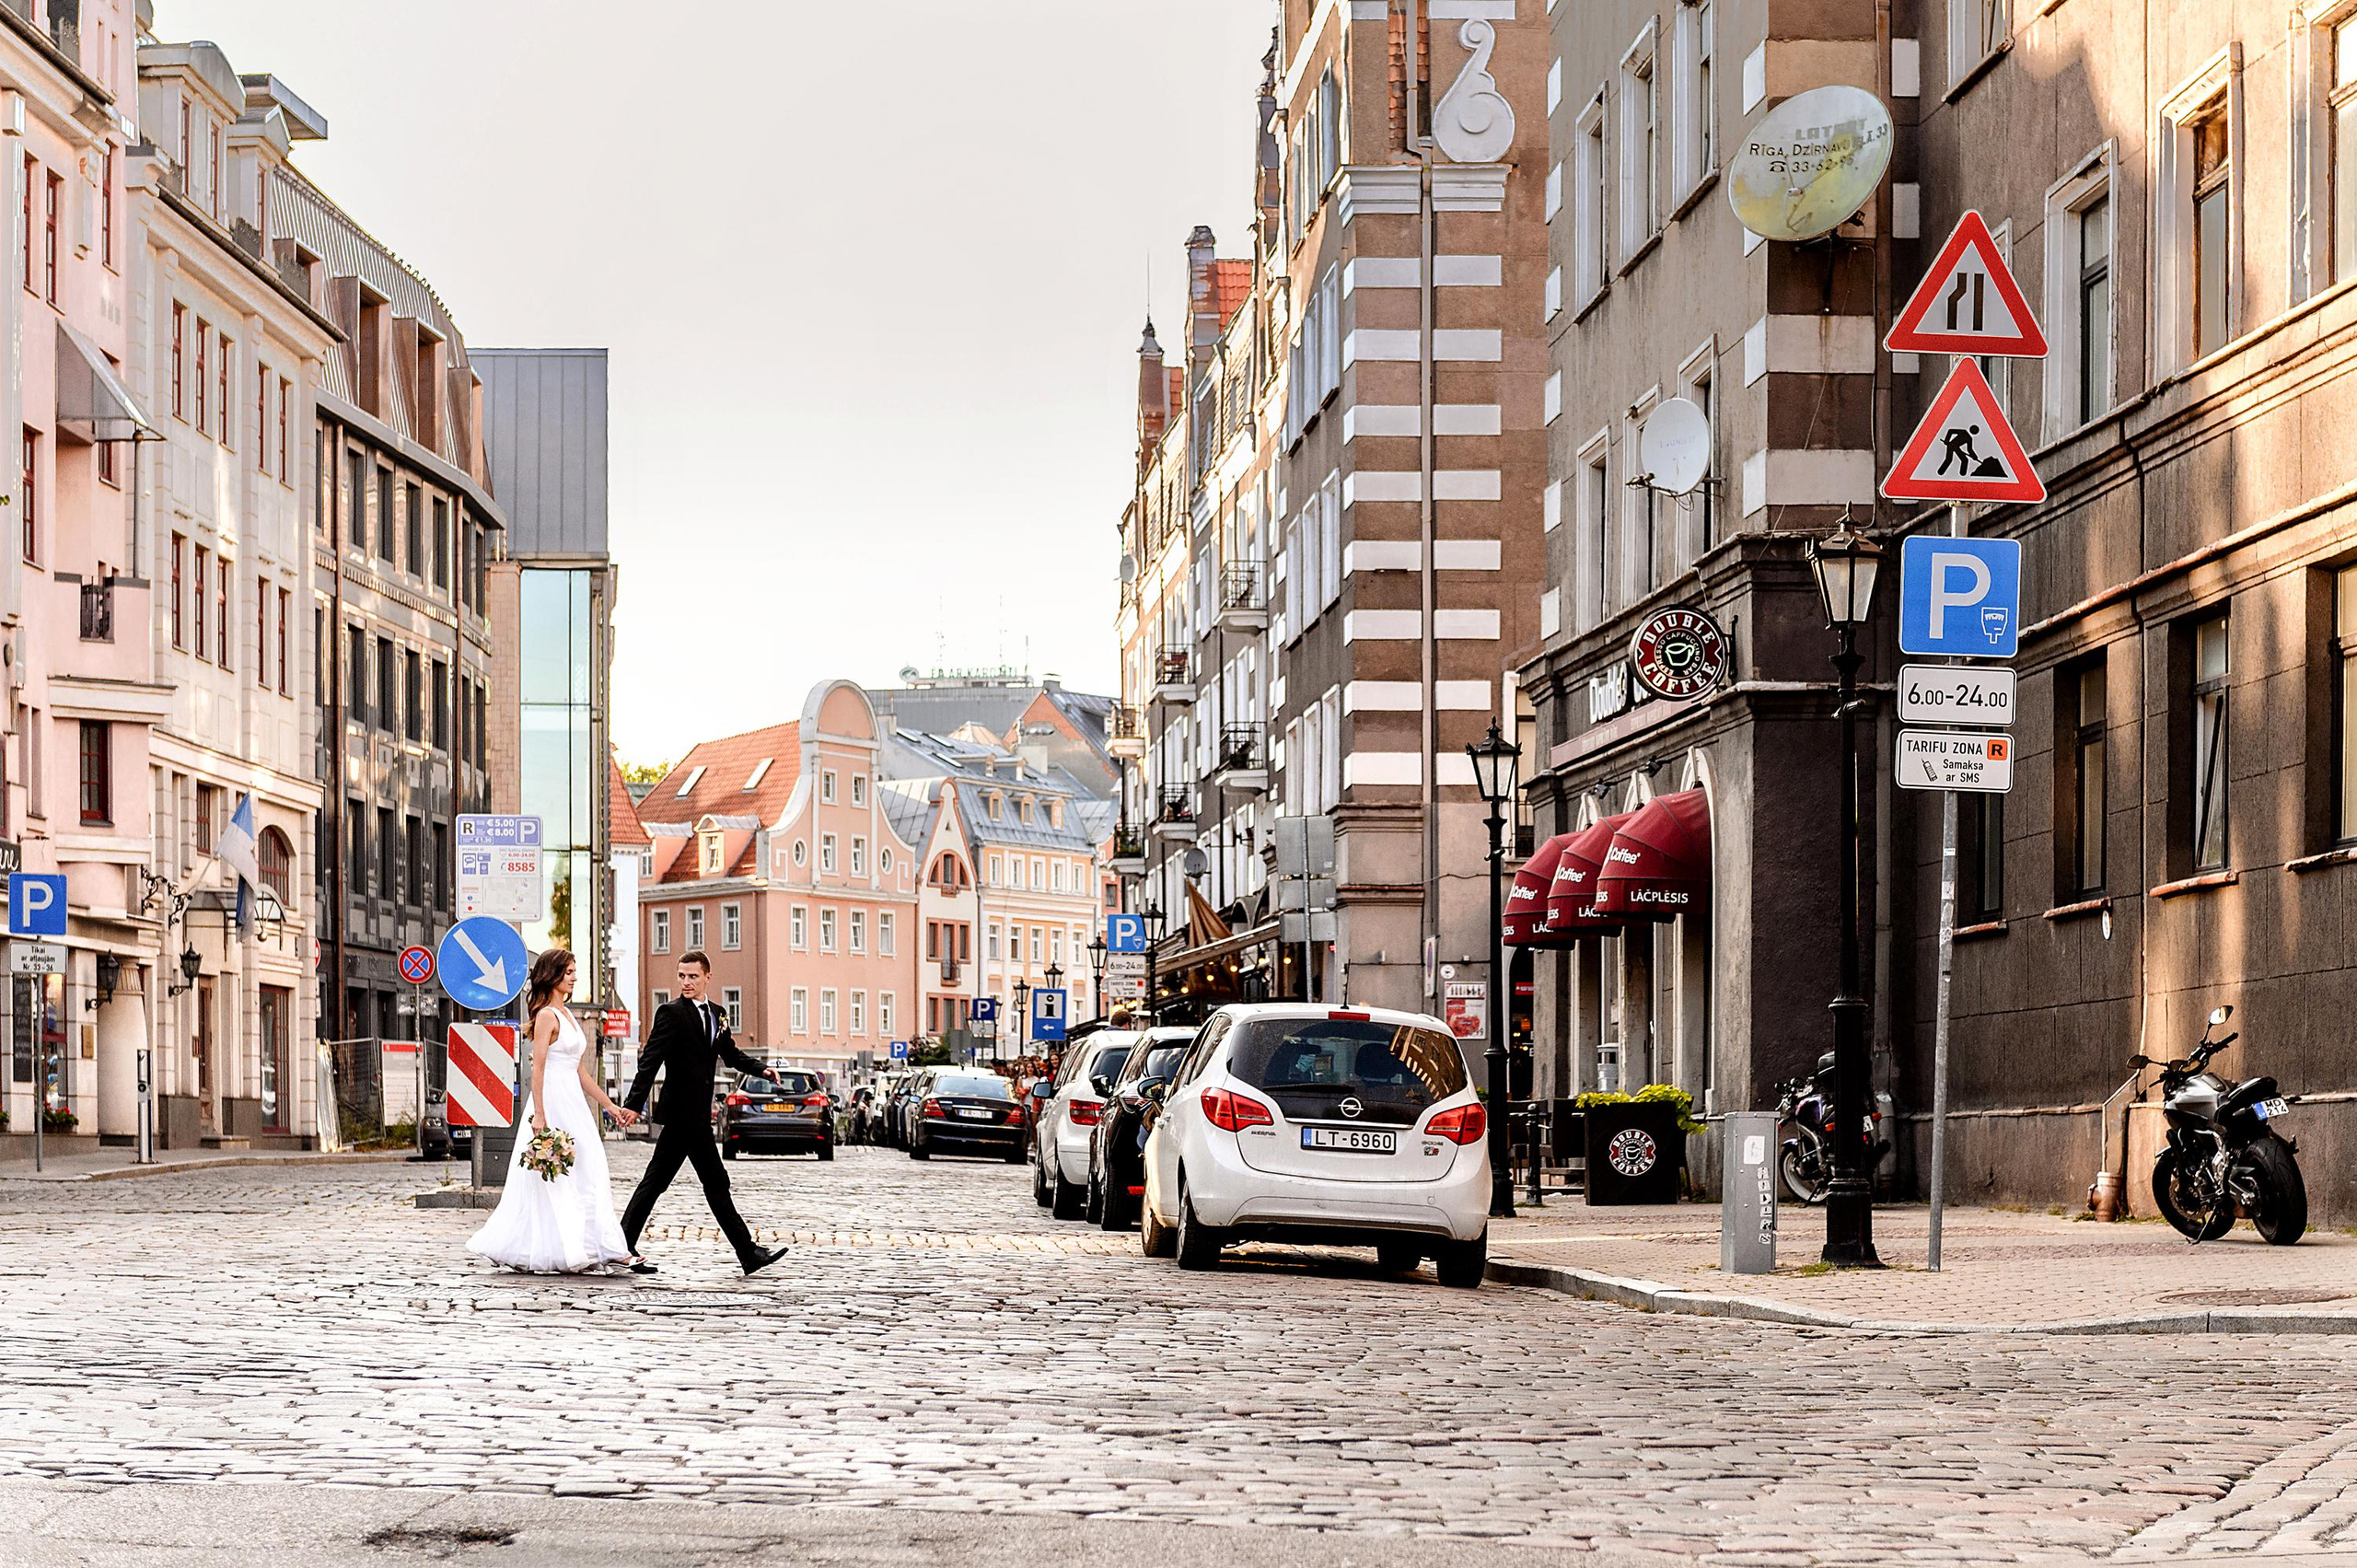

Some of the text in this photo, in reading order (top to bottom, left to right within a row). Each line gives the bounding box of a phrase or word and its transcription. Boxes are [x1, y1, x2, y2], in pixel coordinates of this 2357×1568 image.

[1929, 552, 1991, 639] P
[1643, 614, 1716, 645] DOUBLE
[1666, 632, 1701, 662] CAPPUCCINO
[1643, 662, 1717, 693] COFFEE
[1908, 682, 2008, 708] 6.00-24.00
[1906, 739, 2003, 757] TARIFU ZONA R
[1943, 759, 1984, 772] Samaksa
[1945, 772, 1980, 784] ar SMS
[462, 822, 473, 834] R
[520, 821, 537, 843] P
[507, 862, 536, 873] 8585
[23, 880, 54, 928] P
[1631, 889, 1689, 904] LĀČPLĒSIS
[1116, 919, 1137, 948] P
[977, 1000, 991, 1018] P
[893, 1043, 904, 1056] P
[1314, 1130, 1392, 1150] LT-6960
[1613, 1132, 1653, 1148] DOUBLE
[1613, 1156, 1653, 1174] COFFEE
